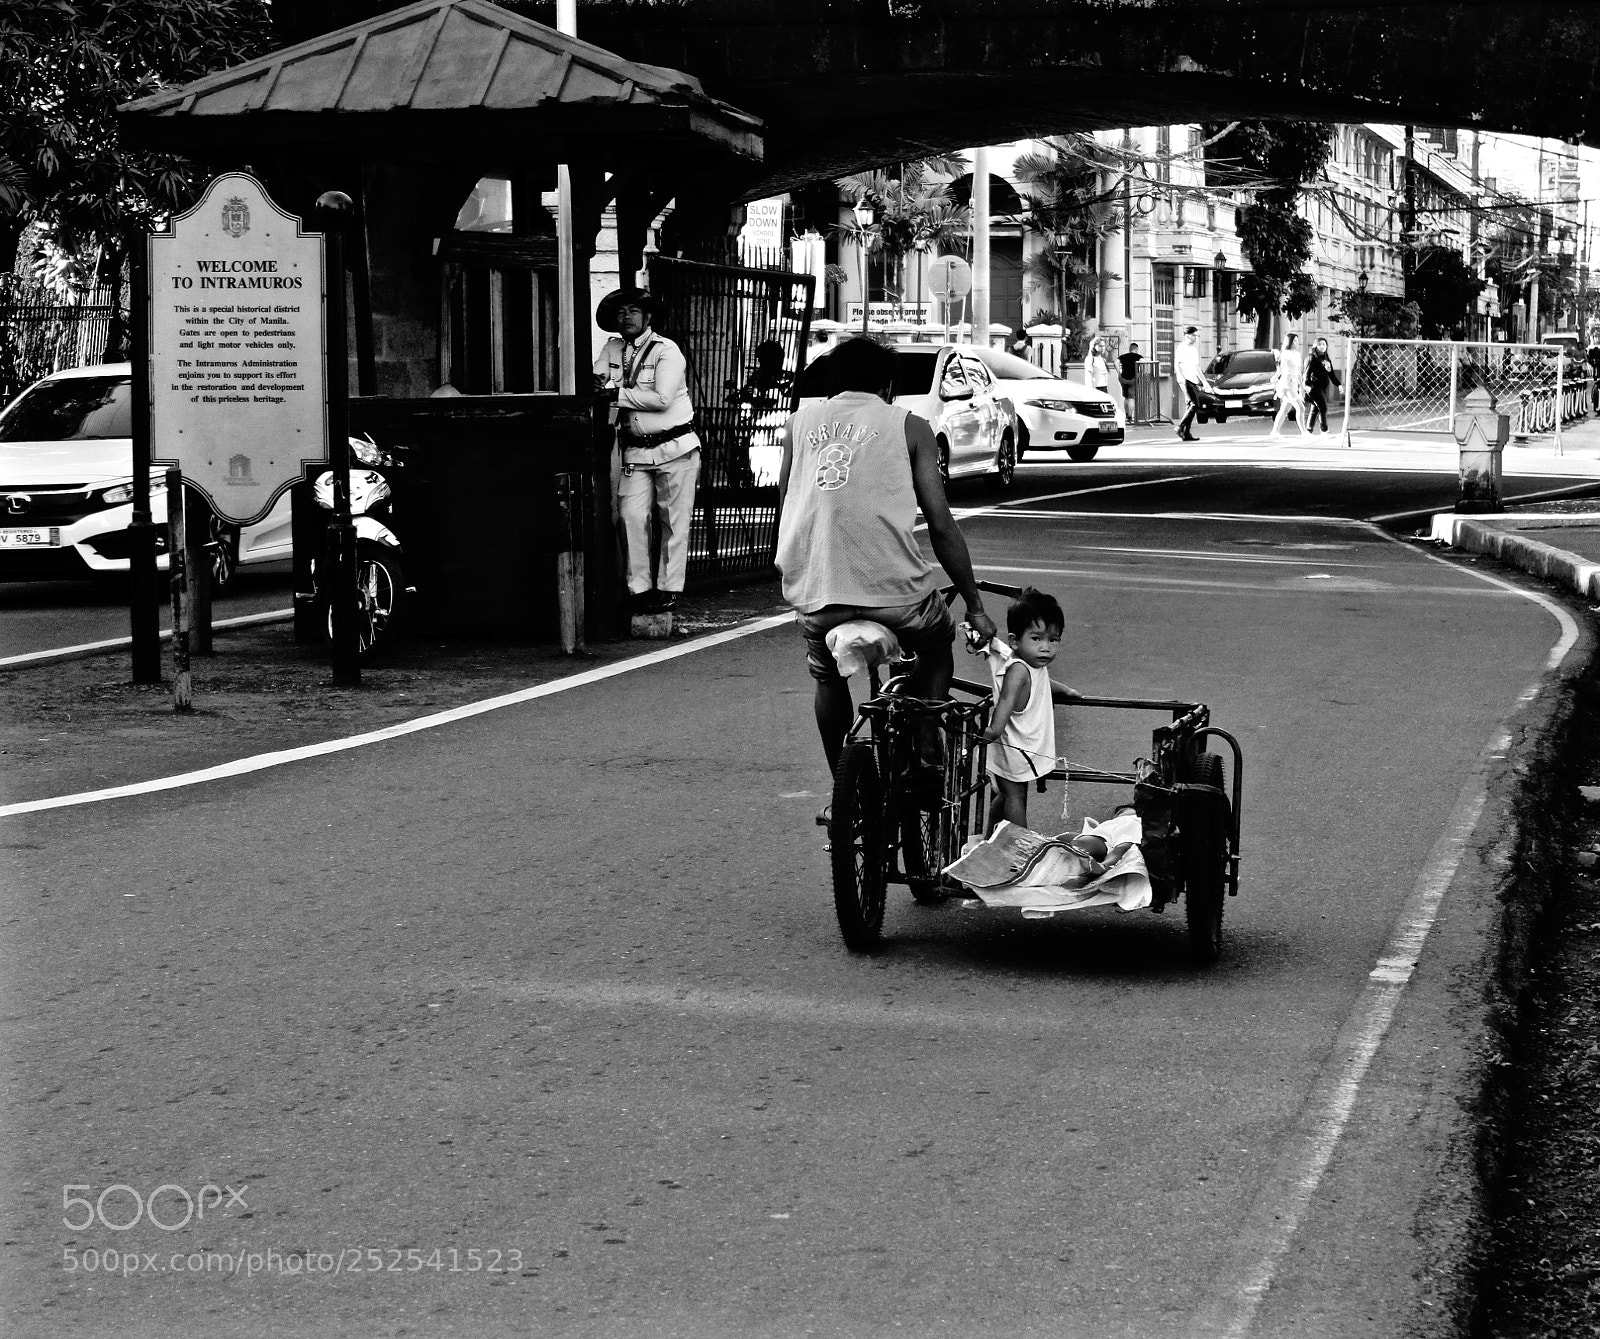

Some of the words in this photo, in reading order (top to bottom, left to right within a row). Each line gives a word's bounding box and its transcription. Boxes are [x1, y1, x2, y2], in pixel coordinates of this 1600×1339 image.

[749, 205, 778, 216] SLOW
[748, 217, 778, 228] DOWN
[752, 229, 776, 237] SCHOOL
[196, 260, 278, 273] WELCOME
[171, 276, 193, 290] TO
[199, 276, 303, 290] INTRAMUROS
[173, 305, 191, 313] This
[192, 305, 200, 313] is
[209, 305, 235, 315] special
[236, 305, 272, 313] historical
[273, 305, 301, 313] district
[852, 308, 875, 316] Plese
[185, 317, 209, 325] within
[212, 317, 225, 325] the
[228, 317, 245, 326] City
[248, 317, 258, 325] of
[260, 317, 290, 325] Manila.
[179, 329, 201, 337] Gates
[242, 329, 250, 337] to
[253, 329, 296, 338] pedestrians
[197, 341, 215, 350] light
[277, 341, 296, 350] only.
[178, 371, 205, 381] enjoins
[206, 373, 221, 381] you
[233, 371, 263, 381] support
[257, 384, 305, 392] development
[217, 395, 250, 404] priceless
[253, 395, 287, 404] heritage.
[806, 421, 880, 448] BRYANT
[815, 443, 853, 491] 8
[15, 534, 41, 543] 5879
